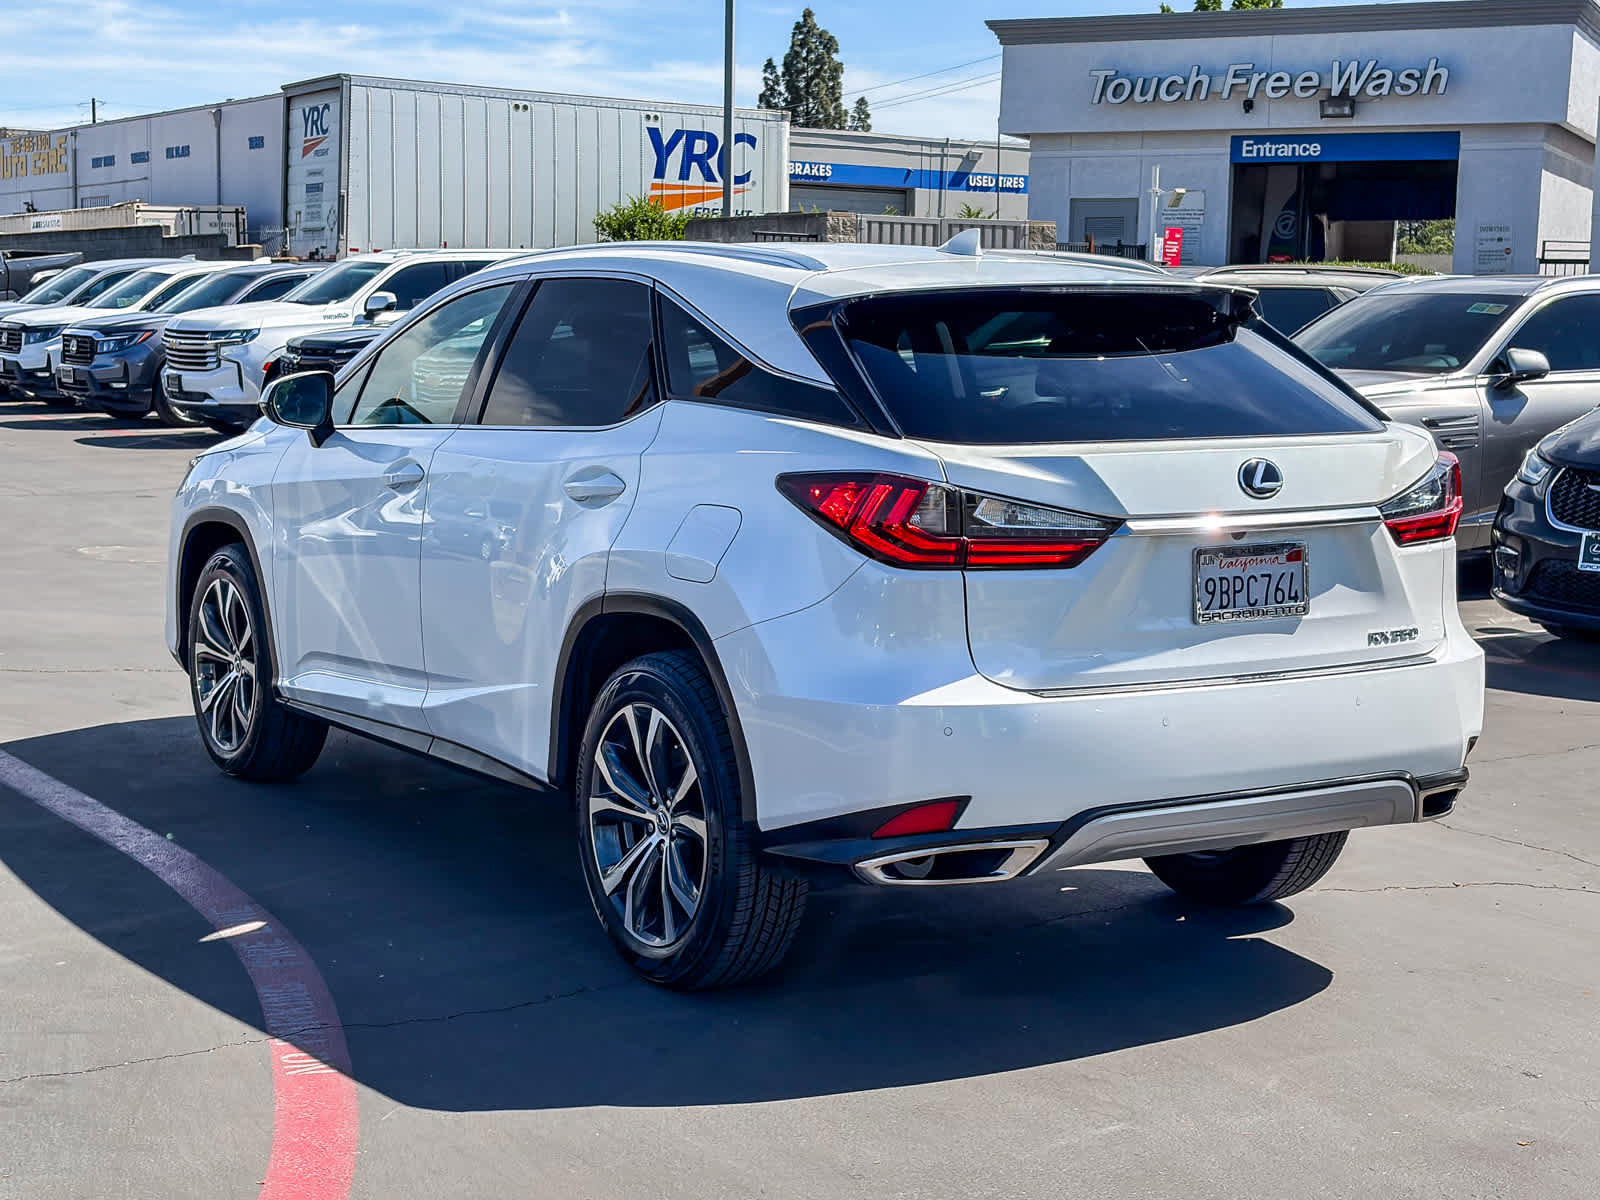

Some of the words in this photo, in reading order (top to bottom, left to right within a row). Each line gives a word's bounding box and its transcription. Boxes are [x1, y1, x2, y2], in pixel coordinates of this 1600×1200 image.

[1088, 66, 1211, 105] Touch
[1221, 62, 1320, 99] Free
[1331, 57, 1450, 97] Wash
[302, 103, 331, 138] YRC
[646, 126, 758, 185] YRC
[1242, 140, 1322, 158] Entrance
[789, 163, 833, 177] BRAKES
[969, 174, 996, 188] USED
[1201, 554, 1215, 566] JUN
[1217, 556, 1287, 573] California
[1204, 572, 1299, 611] 9BPC764
[1201, 604, 1307, 623] SACRAMENTO
